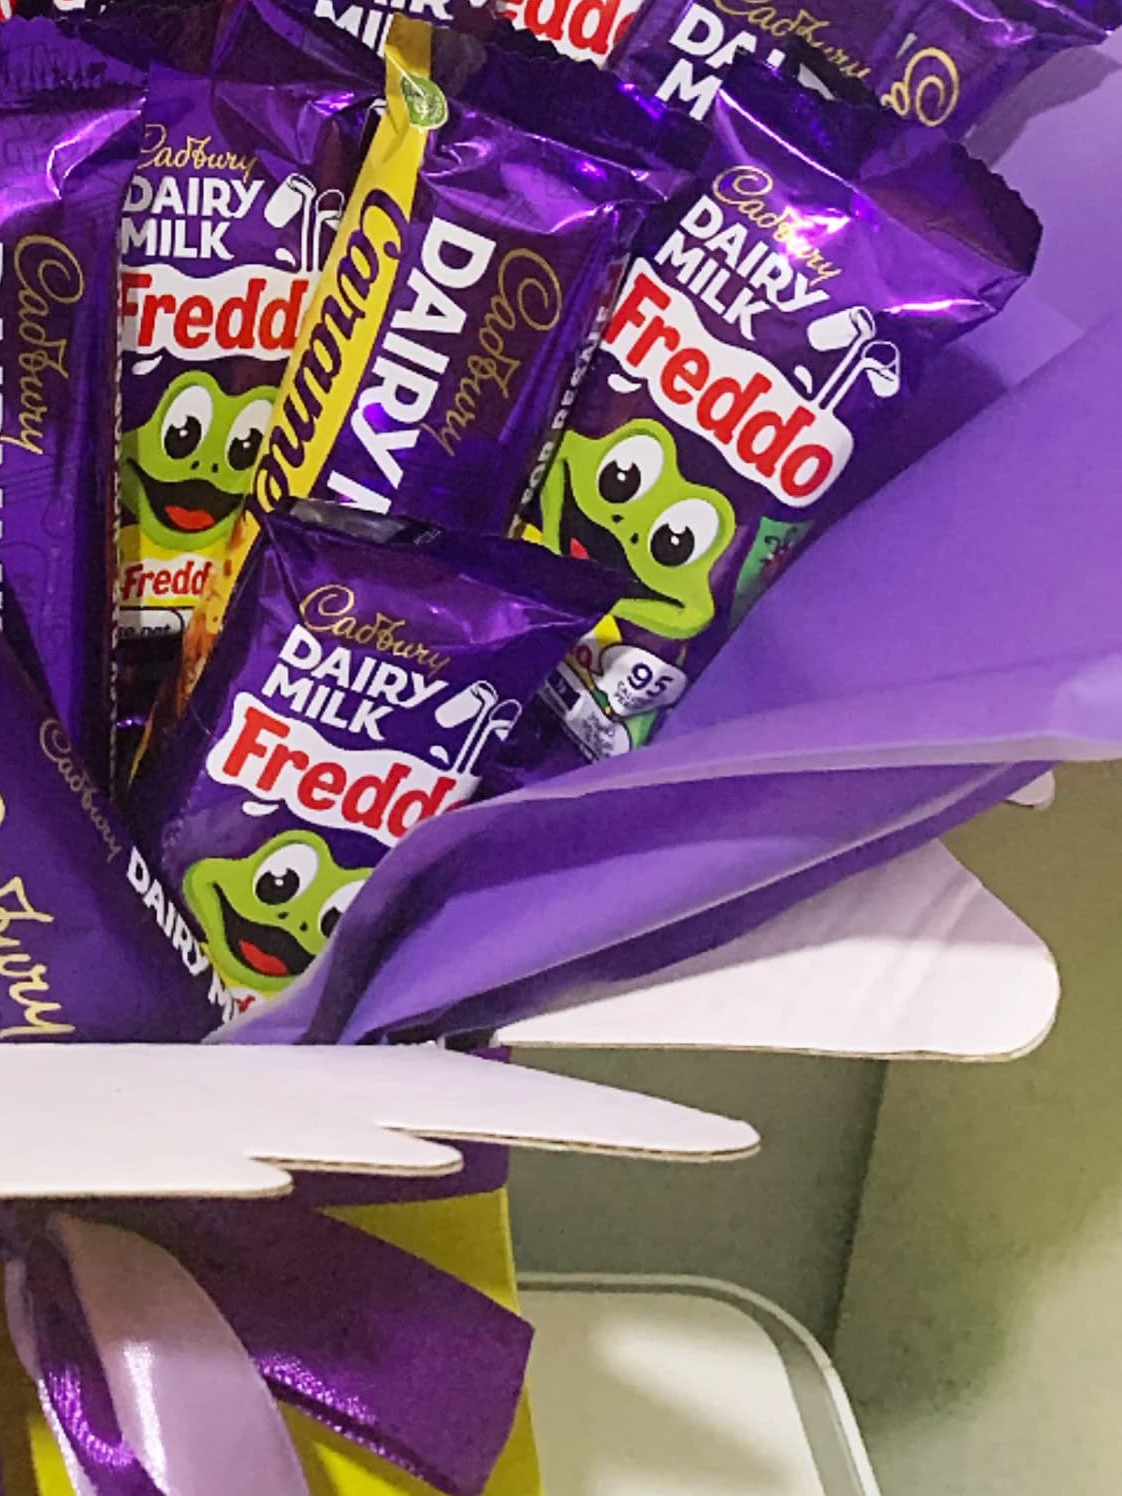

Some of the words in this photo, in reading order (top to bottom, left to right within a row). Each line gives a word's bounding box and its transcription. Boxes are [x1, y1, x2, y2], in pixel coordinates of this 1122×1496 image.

[121, 219, 234, 261] MILK
[122, 176, 264, 219] DAIRY
[654, 228, 769, 342] MILK
[679, 194, 830, 313] DAIRY
[0, 234, 84, 455] Cadbury
[120, 273, 310, 350] Fredd
[349, 216, 496, 490] DAIRY
[422, 248, 562, 456] Cadbury
[603, 272, 834, 499] Freddo
[120, 560, 213, 601] Fredd
[299, 584, 452, 679] Cadbury
[262, 662, 397, 741] MILK
[279, 624, 448, 708] DAIRY
[222, 706, 468, 838] Fredd
